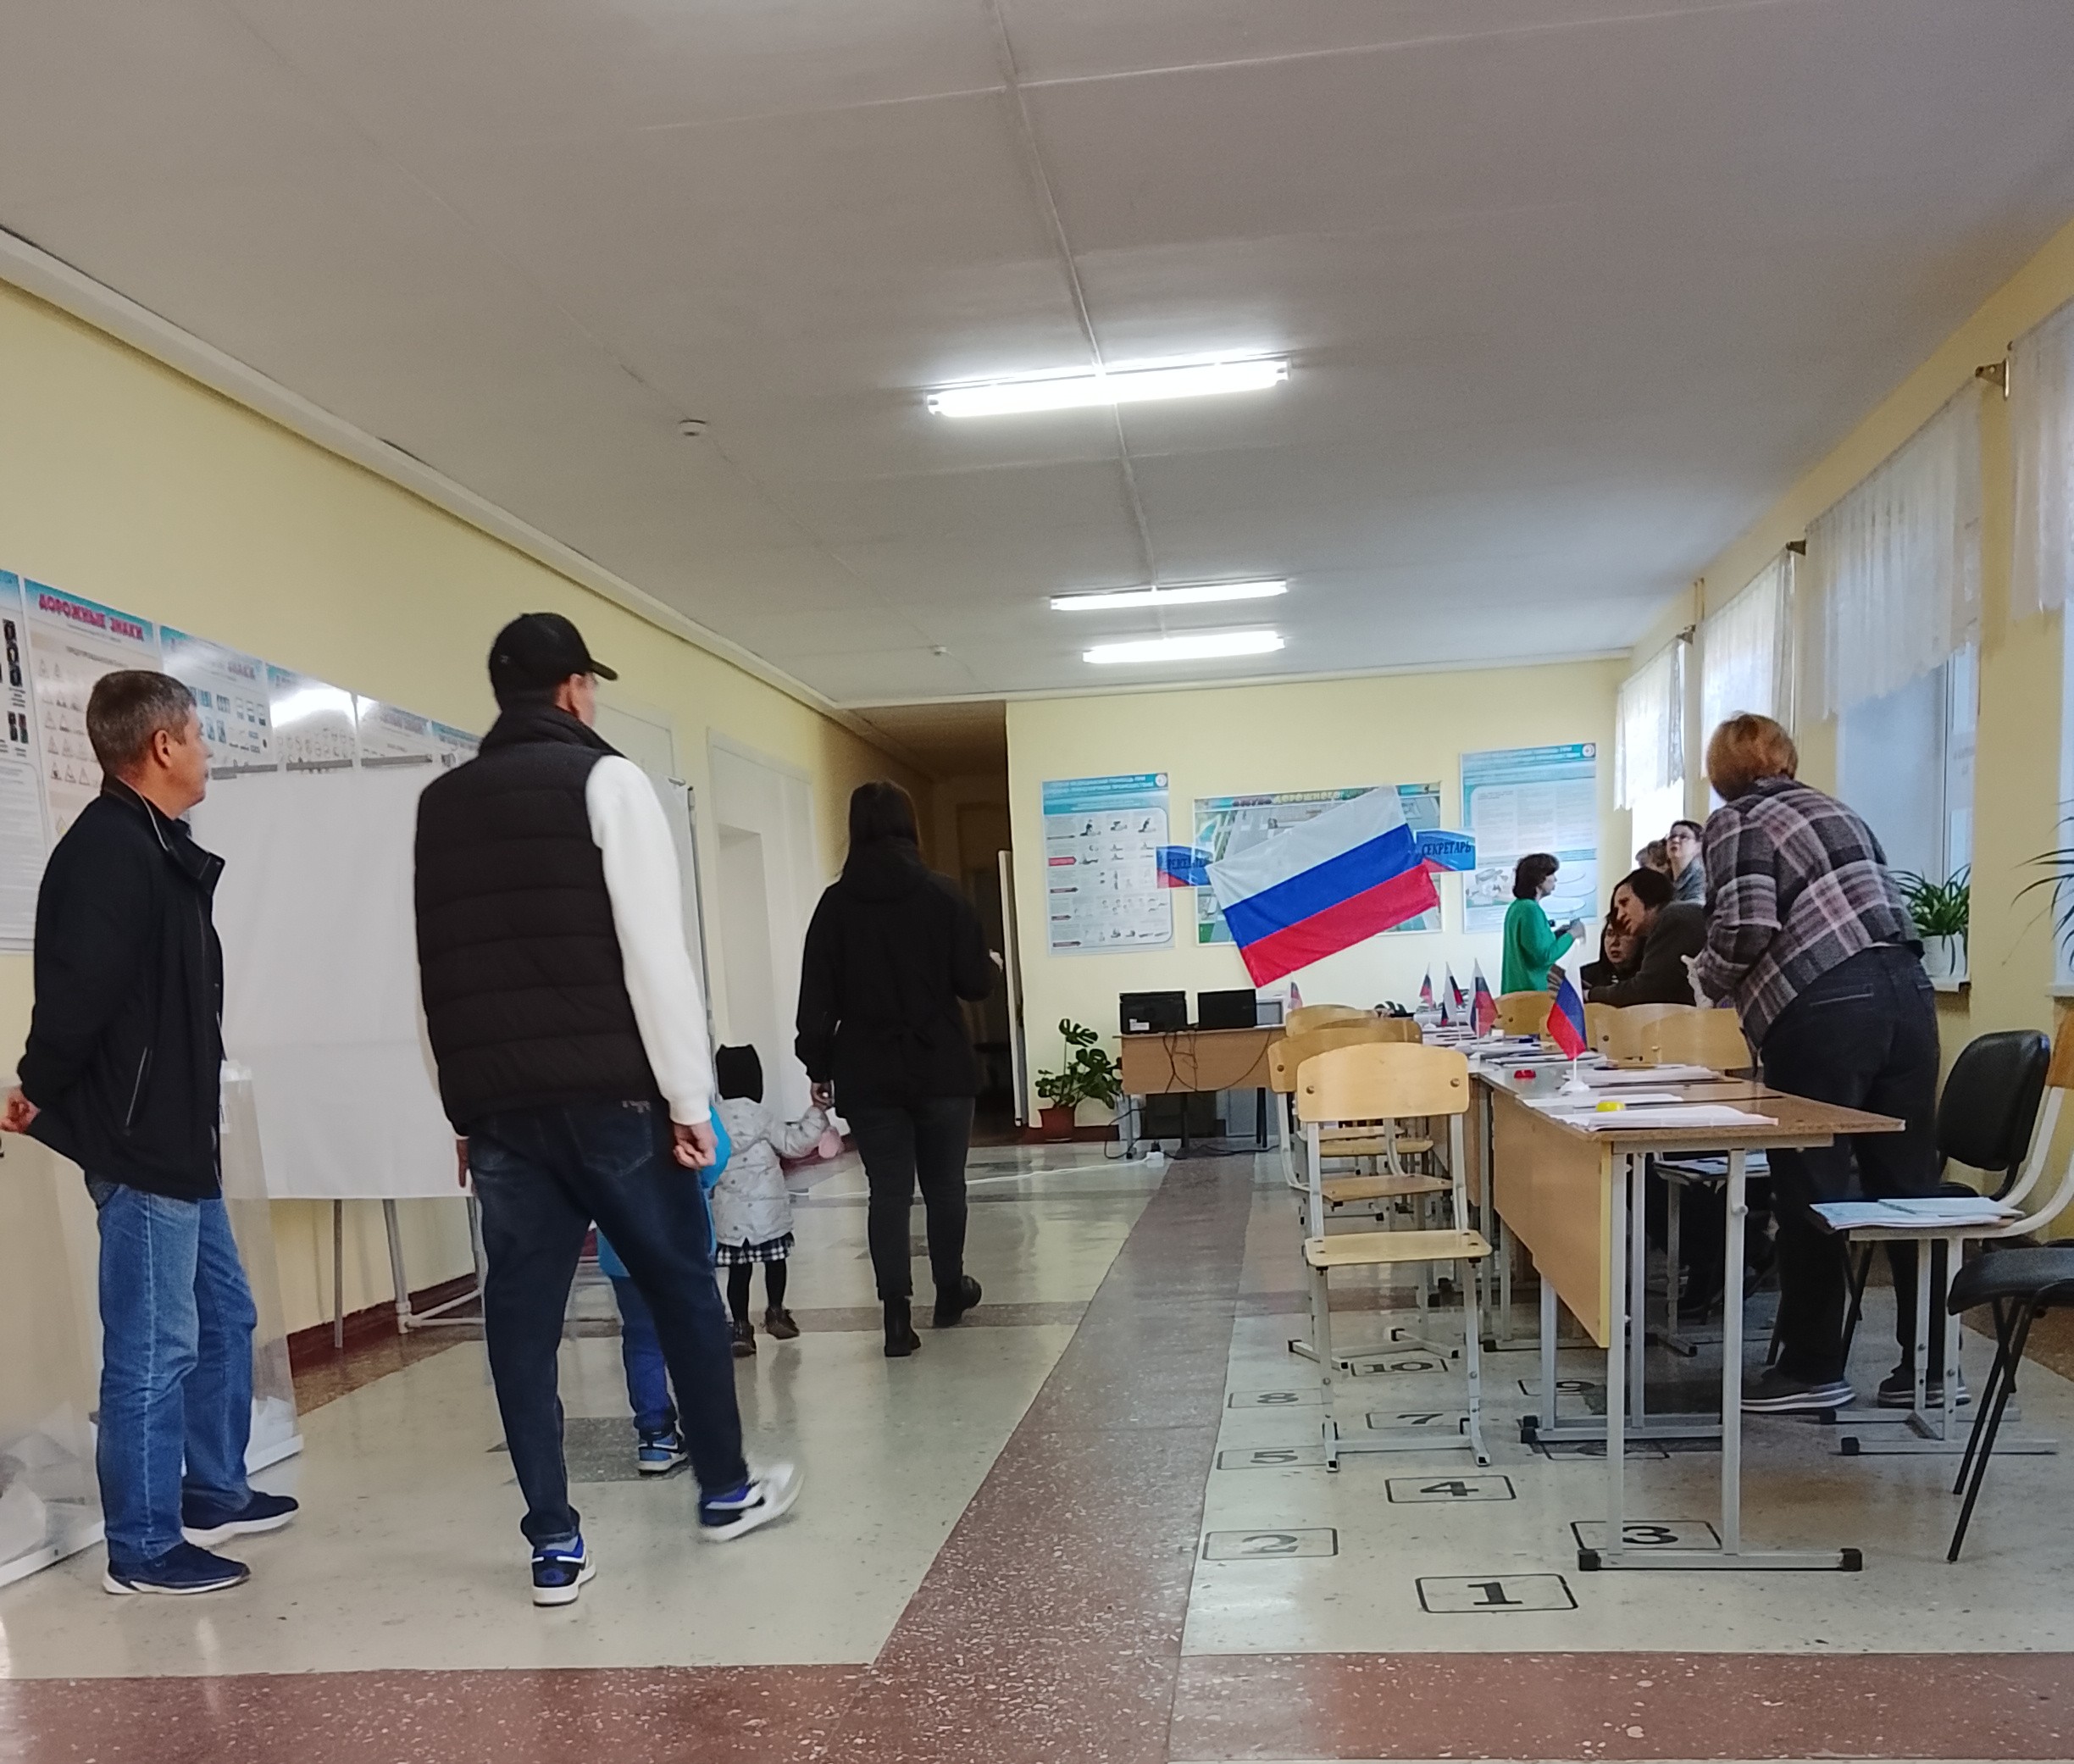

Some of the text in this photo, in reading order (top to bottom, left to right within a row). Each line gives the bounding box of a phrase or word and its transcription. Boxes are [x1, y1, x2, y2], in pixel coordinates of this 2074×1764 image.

[110, 617, 144, 641] ЗНАКИ
[1422, 840, 1472, 856] СЕКРЕТАРЬ
[1363, 1361, 1434, 1373] 10
[1256, 1392, 1299, 1403] 8
[1396, 1413, 1444, 1425] 7
[1250, 1450, 1299, 1464] 5
[1420, 1480, 1479, 1496] 4
[1622, 1526, 1679, 1545] 3
[1241, 1534, 1299, 1554] 2
[1467, 1581, 1523, 1606] 1
